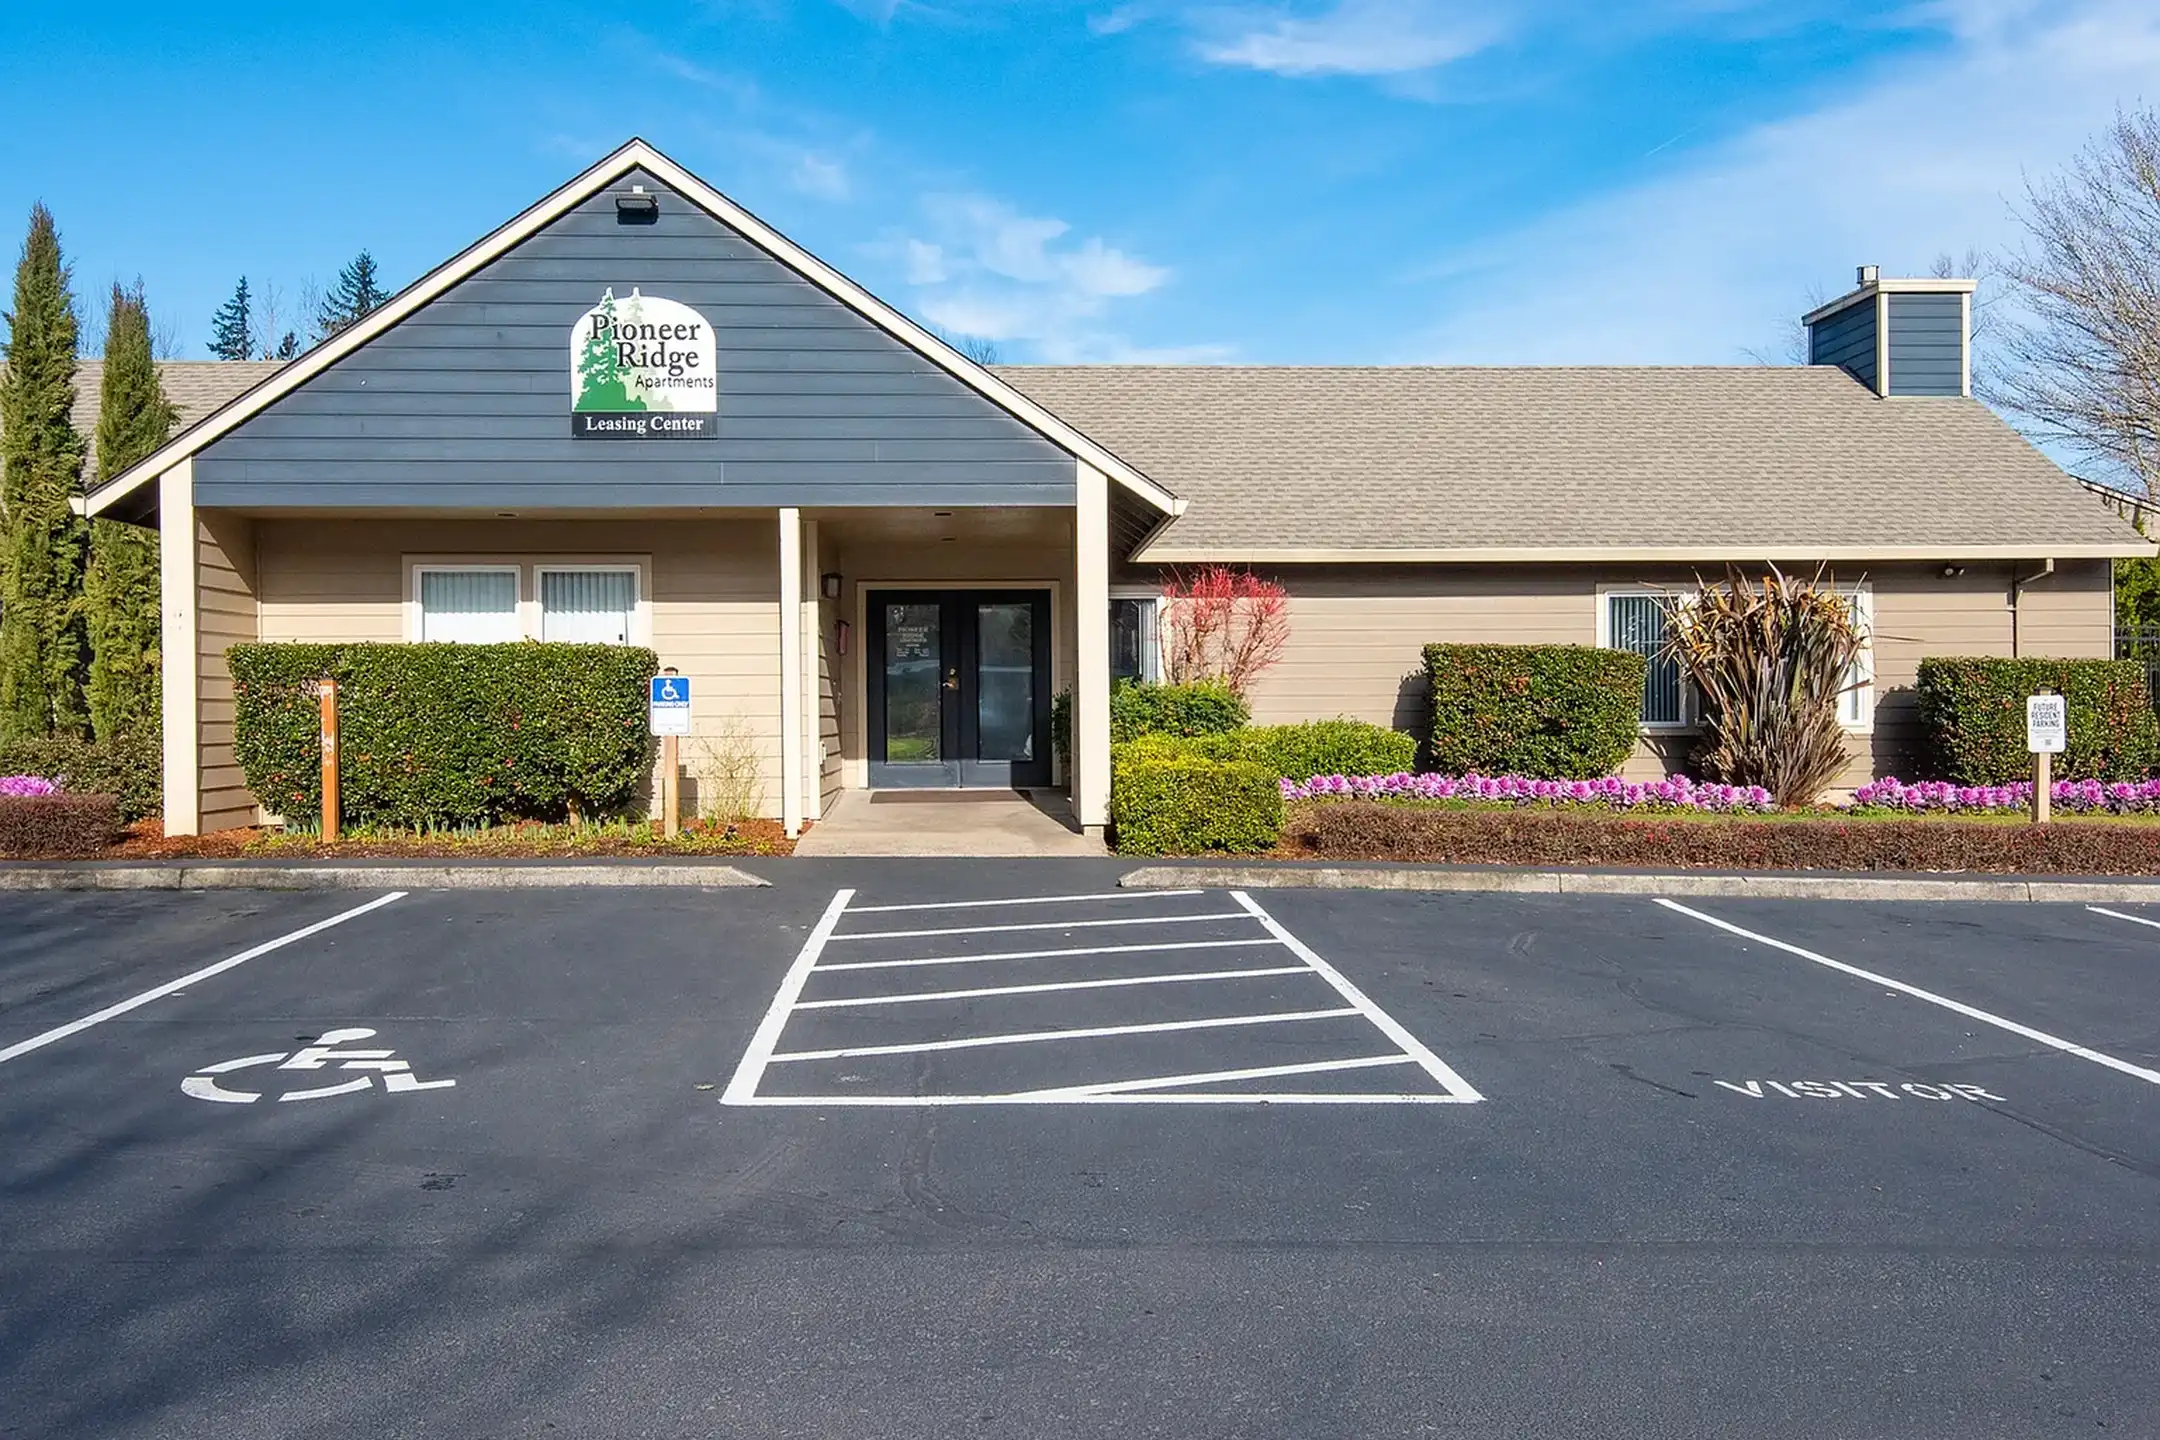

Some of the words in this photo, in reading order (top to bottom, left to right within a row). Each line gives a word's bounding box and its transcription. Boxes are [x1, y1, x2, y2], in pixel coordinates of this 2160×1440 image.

[590, 314, 701, 341] Pioneer
[616, 341, 699, 376] Ridge
[635, 375, 714, 391] Apartments
[586, 417, 647, 434] Leasing
[650, 417, 704, 431] Center
[2033, 702, 2058, 711] FUTURE
[2031, 711, 2061, 720] RESIDENT
[2032, 719, 2060, 728] PARKING
[1713, 1080, 2008, 1101] VISITOR
